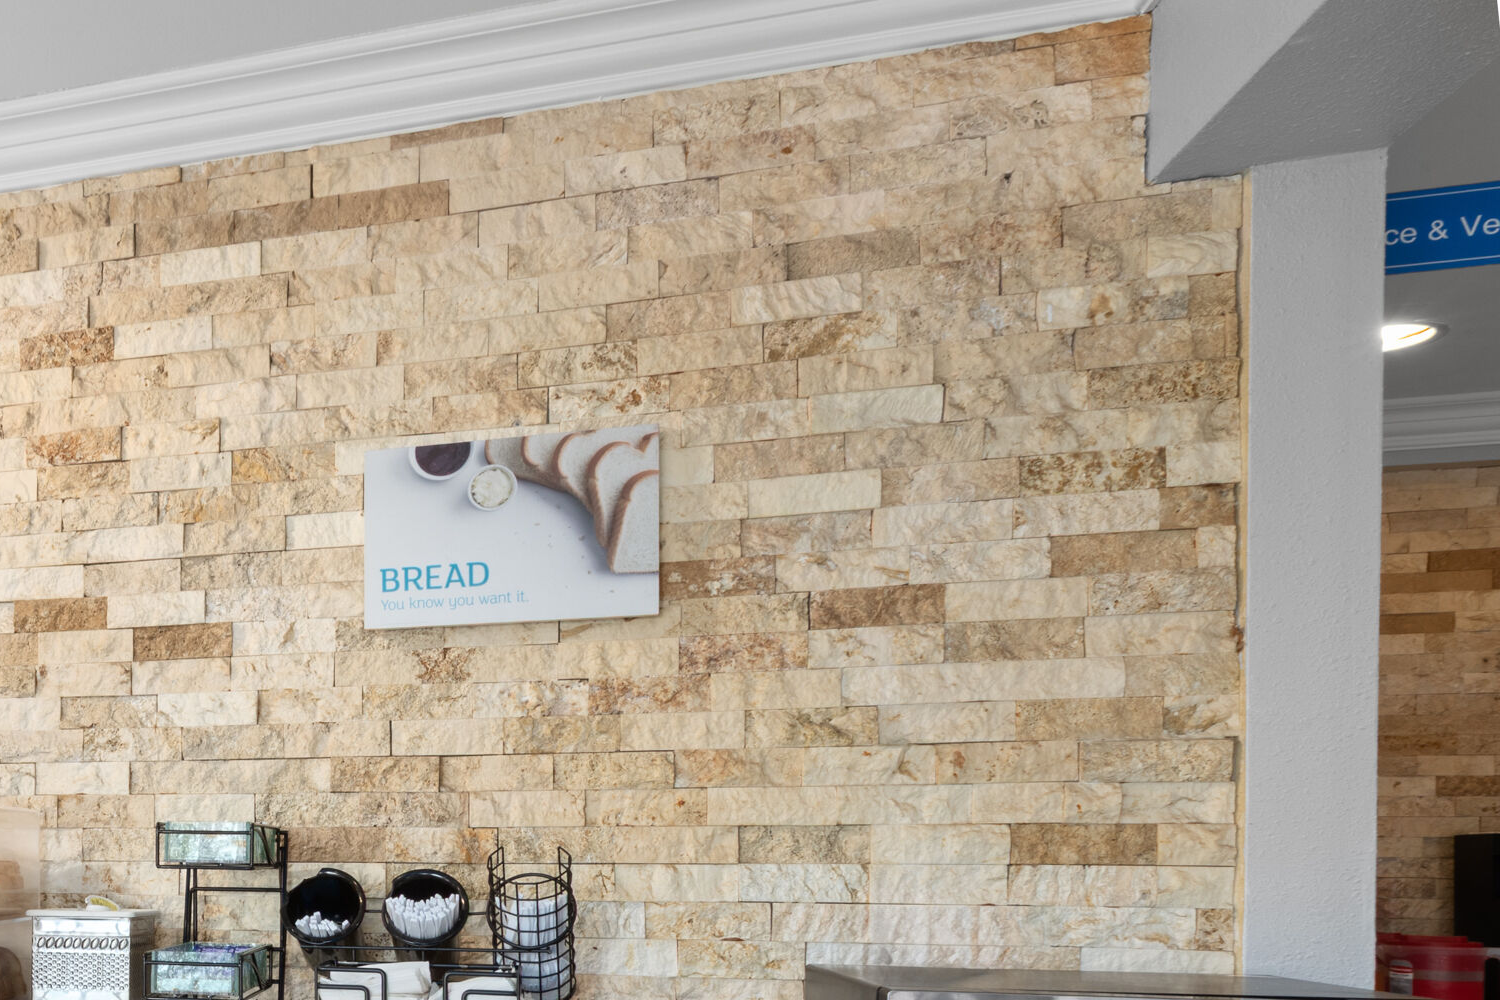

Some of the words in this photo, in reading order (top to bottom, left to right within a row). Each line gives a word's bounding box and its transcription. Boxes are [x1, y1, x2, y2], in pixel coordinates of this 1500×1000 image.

[1428, 219, 1449, 241] &
[379, 561, 490, 593] BREAD
[381, 599, 405, 611] You
[408, 596, 445, 610] know
[448, 595, 475, 610] you
[478, 591, 512, 606] want
